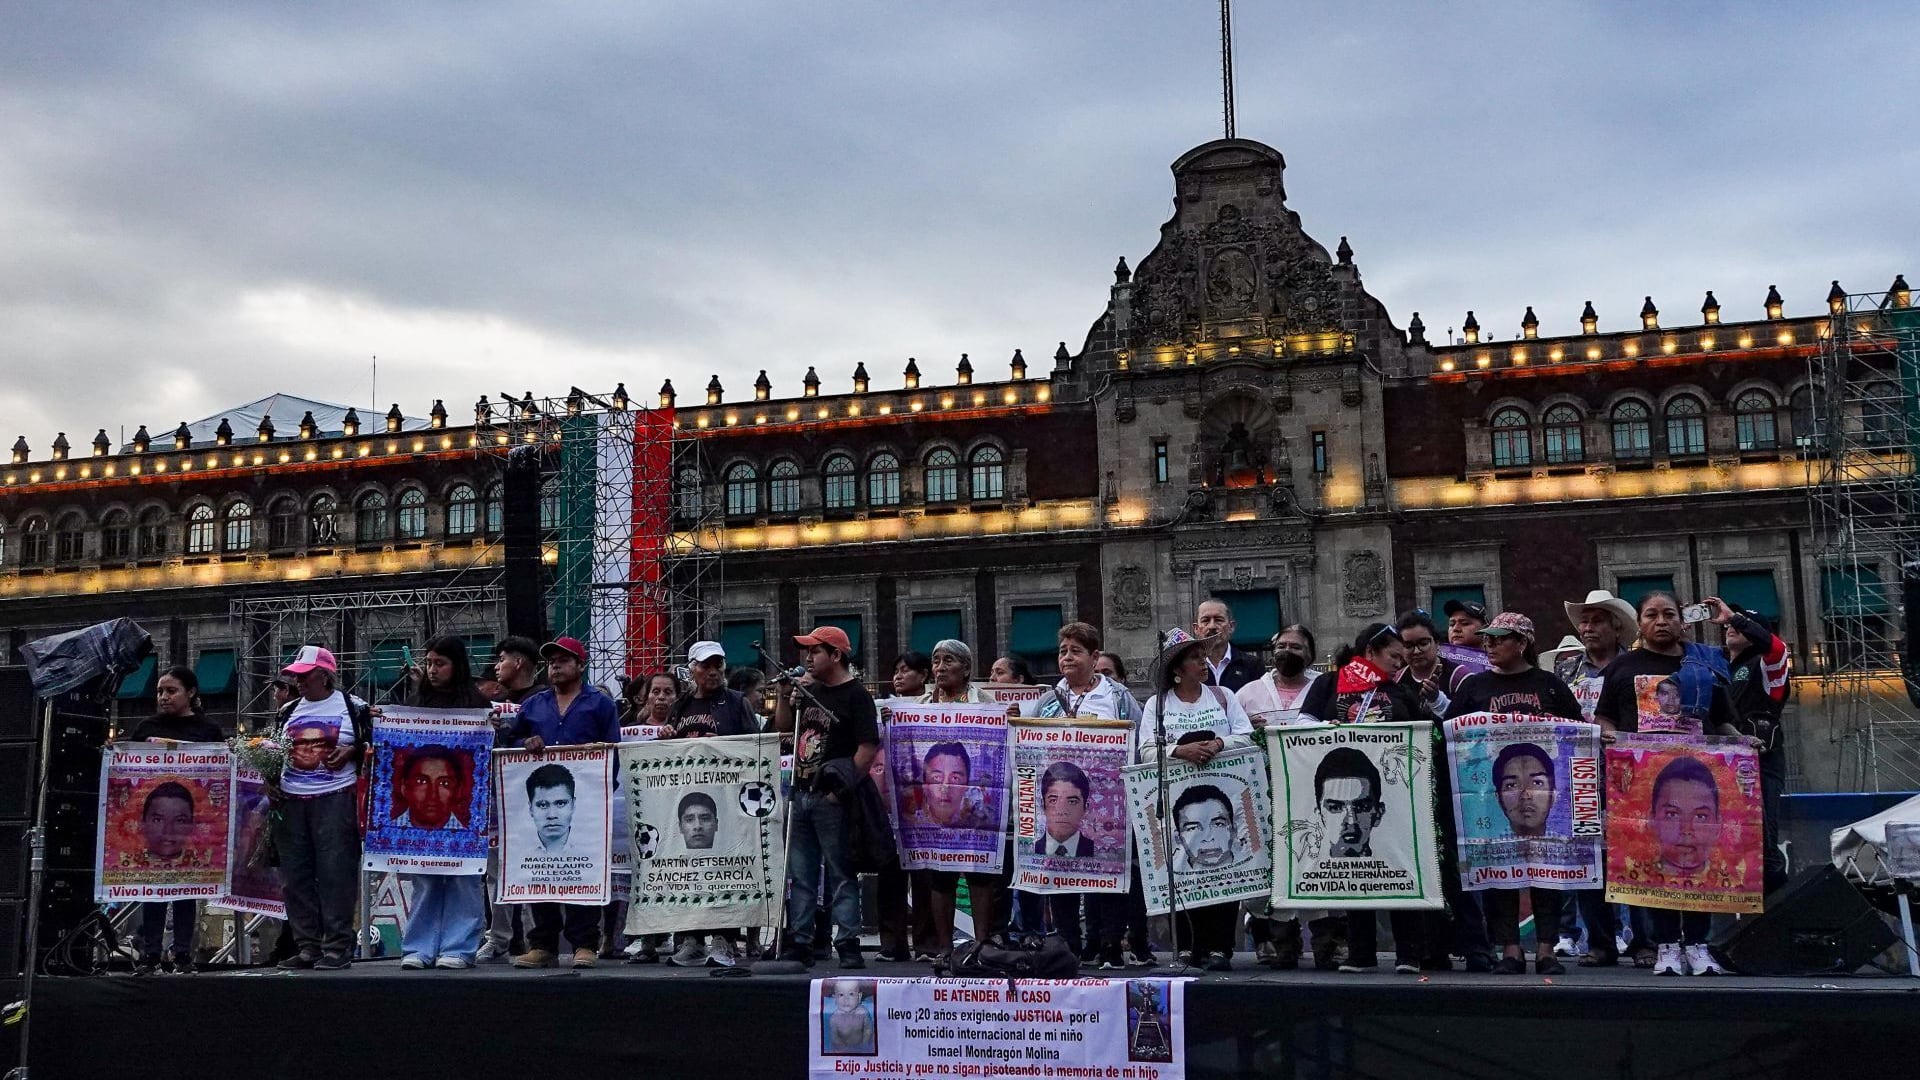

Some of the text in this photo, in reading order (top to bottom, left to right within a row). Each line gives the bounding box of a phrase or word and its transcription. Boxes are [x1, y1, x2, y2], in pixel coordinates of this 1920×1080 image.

[1489, 692, 1542, 713] AYOTZINAPA
[380, 715, 410, 724] ¡Porque
[413, 717, 430, 725] vivo
[452, 718, 488, 726] llevaron!
[892, 712, 1006, 726] ¡Vivo se lo llevaron!
[1454, 715, 1487, 730] ¡Vivo
[1492, 714, 1507, 724] se
[1512, 711, 1523, 723] lo
[641, 728, 654, 736] se
[1016, 729, 1043, 743] ¡Vivo
[1046, 732, 1059, 741] se
[1062, 730, 1072, 742] lo
[1075, 731, 1127, 744] llevaron!
[1286, 731, 1403, 749] ¡Vivo se lo llevaron!
[112, 752, 229, 765] ¡Vivo se lo llevaron!
[503, 750, 605, 765] ¡Vivo se lo llevaron!
[1138, 769, 1160, 782] ¡Viv
[1170, 767, 1181, 777] se
[1183, 764, 1194, 775] lo
[1573, 757, 1596, 779] NOS
[646, 772, 740, 789] ¡VIVO SE LO LLEVARON!
[1019, 779, 1035, 814] FALTAN
[1574, 782, 1597, 820] FALTAN
[1020, 816, 1034, 837] NOS
[387, 857, 408, 867] ¡Vivo
[420, 860, 463, 868] queremos!
[651, 855, 756, 868] MARTÍN GETSEMANY
[909, 849, 989, 863] ¡Vivo lo ueremos!
[1319, 859, 1388, 869] CÉSAR MANUEL
[648, 867, 754, 883] SÁNCHEZ GARCÍA
[1020, 871, 1118, 889] ¡Vivo lo queremos!
[1158, 867, 1269, 891] BEJAMÍN ASCENCIO BAUTISTA
[1302, 869, 1407, 879] GONZÁLEZ HERNÁNDEZ
[1476, 866, 1587, 883] ¡Vivo lo queremos!
[109, 885, 218, 898] ¡Vivo lo queremos!
[507, 884, 525, 896] ¡Con
[528, 884, 547, 895] VIDA
[549, 884, 558, 895] lo
[559, 884, 601, 897] queremos!
[643, 882, 760, 892] ¡Con VIDA lo queremos!
[1162, 881, 1272, 908] ¡Cn VIDA lo queremos!
[1296, 880, 1414, 894] ¡Con VIDA lo queremos!
[219, 896, 285, 913] ¡Vivo lo queremos!
[934, 989, 948, 1001] DE
[951, 989, 1000, 1002] ATENDER
[1021, 990, 1051, 1003] CASO
[888, 1007, 1099, 1026] llevo ¡20 años exigiendo JUSTICIA por el
[905, 1026, 1083, 1041] homicidio internacional de mi niño
[928, 1044, 1060, 1062] Ismael Mondragón Molina
[835, 1060, 1159, 1080] Exijo Justicia y que no sigan pisoteando la memoria de mi hijo
